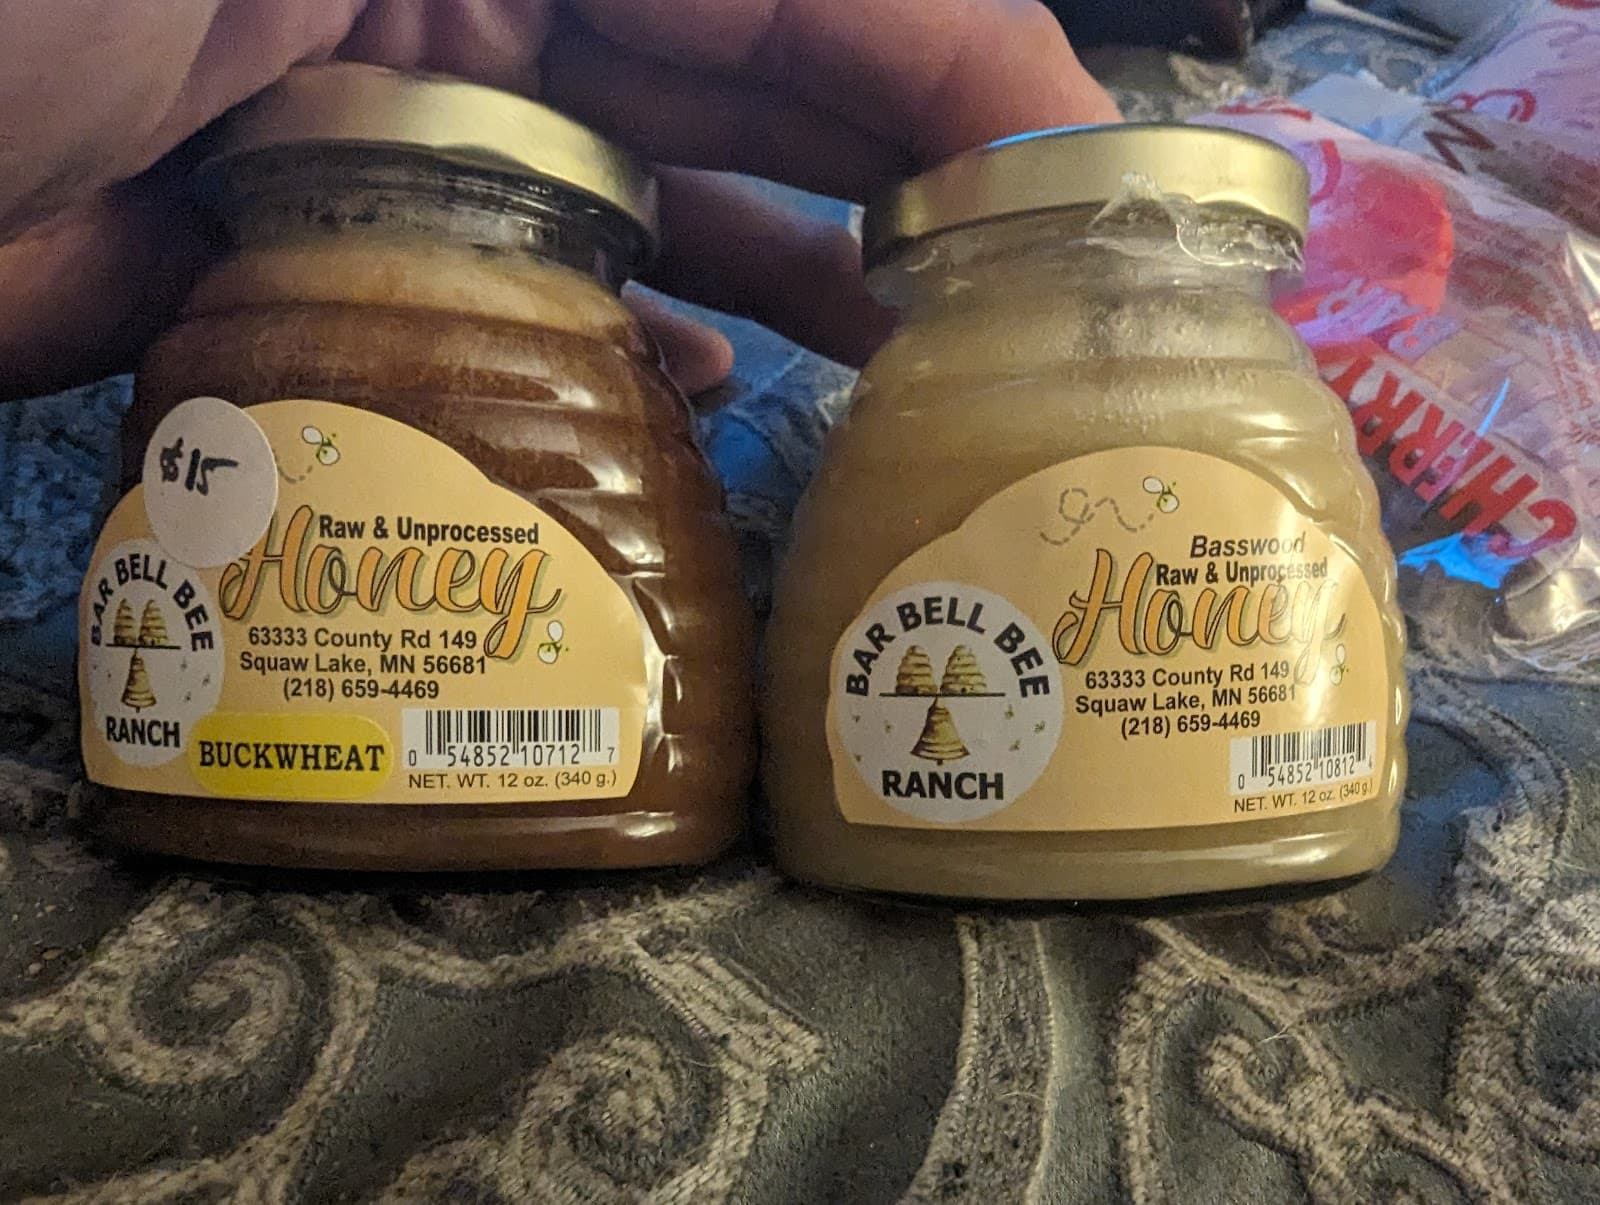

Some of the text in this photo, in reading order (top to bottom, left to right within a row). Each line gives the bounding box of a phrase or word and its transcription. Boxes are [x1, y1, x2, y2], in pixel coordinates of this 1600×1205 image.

[159, 437, 239, 495] $15
[319, 514, 539, 545] Raw & Unprocessed
[1190, 531, 1306, 558] Basswood
[219, 504, 562, 659] Honey
[1156, 557, 1328, 587] Raw & Unprocessed
[91, 553, 213, 651] BAR BELL BEE
[1052, 548, 1346, 686] Honey
[248, 626, 477, 651] 63333 County Rd 149
[846, 596, 1050, 698] BAR BELL BEE
[240, 652, 486, 676] Squaw Lake, MN 56681
[1085, 660, 1290, 690] 63333 County Rd 149
[283, 677, 439, 702] (218) 659-4469
[1075, 684, 1296, 717] Squaw Lake, MN 56681
[106, 716, 180, 748] RANCH
[1120, 708, 1261, 738] (218) 659-4469
[199, 740, 385, 772] BUCKWHEAT
[408, 744, 616, 767] 0 54852 10712 7
[409, 770, 617, 789] NET. WT. 12 oz. (340 g.)
[882, 770, 1004, 801] RANCH
[1238, 773, 1245, 790] 0
[1268, 762, 1312, 788] 54852
[1319, 755, 1355, 781] 10812
[1234, 796, 1268, 813] NET.
[1272, 792, 1297, 809] WT.
[1302, 790, 1316, 804] 12
[1319, 790, 1335, 802] oz.
[1339, 781, 1361, 799] (340
